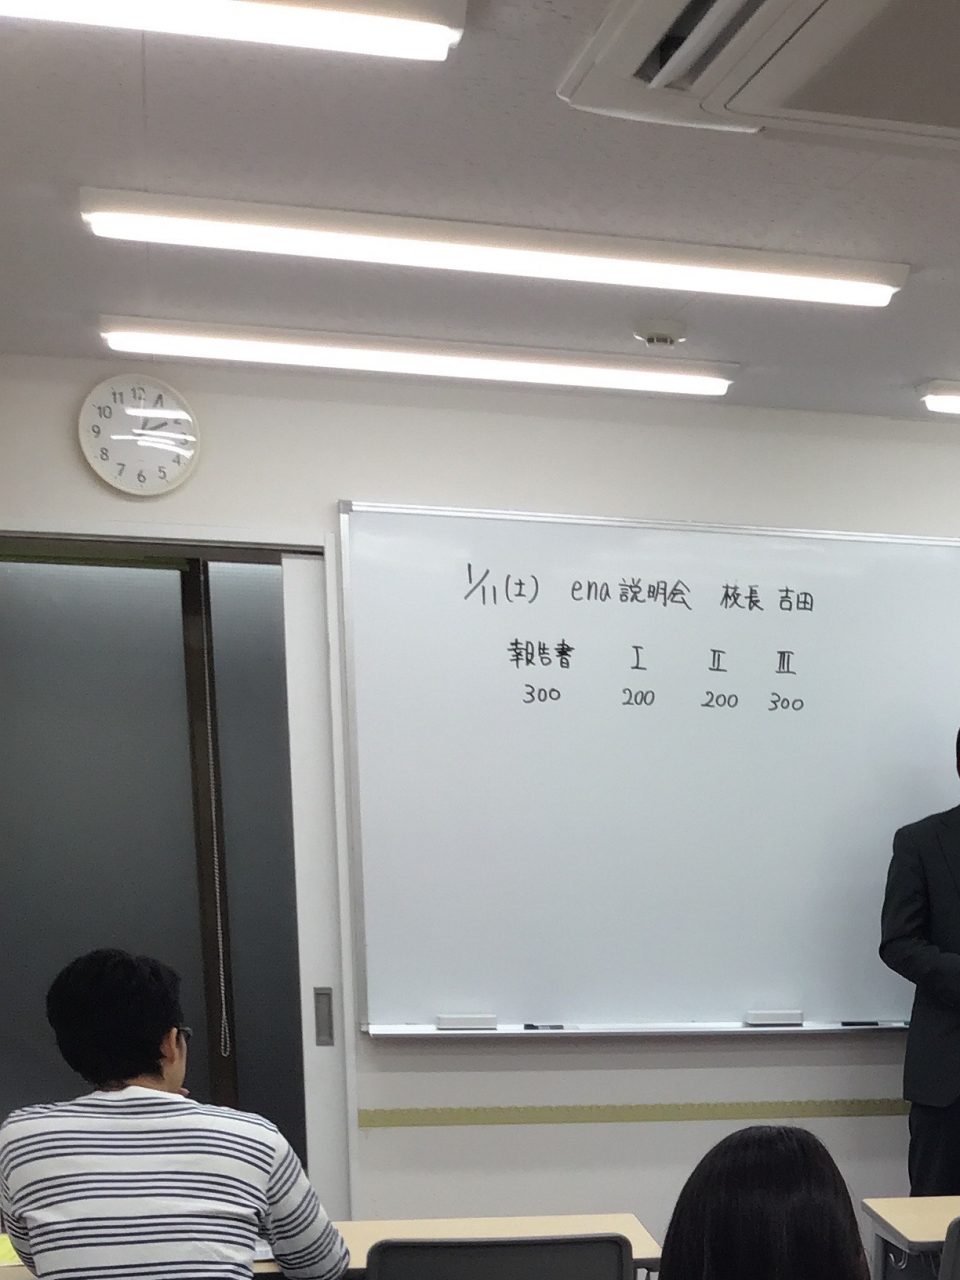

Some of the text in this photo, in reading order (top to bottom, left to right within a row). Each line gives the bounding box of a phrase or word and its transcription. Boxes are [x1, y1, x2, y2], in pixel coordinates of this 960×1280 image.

[112, 391, 124, 404] 11
[97, 406, 112, 419] 10
[91, 424, 101, 438] 9
[100, 447, 109, 461] 8
[116, 462, 126, 476] 7
[137, 469, 146, 483] 6
[158, 466, 166, 479] 5
[507, 638, 575, 670] 報告書
[522, 684, 805, 712] 300 200 200 300
